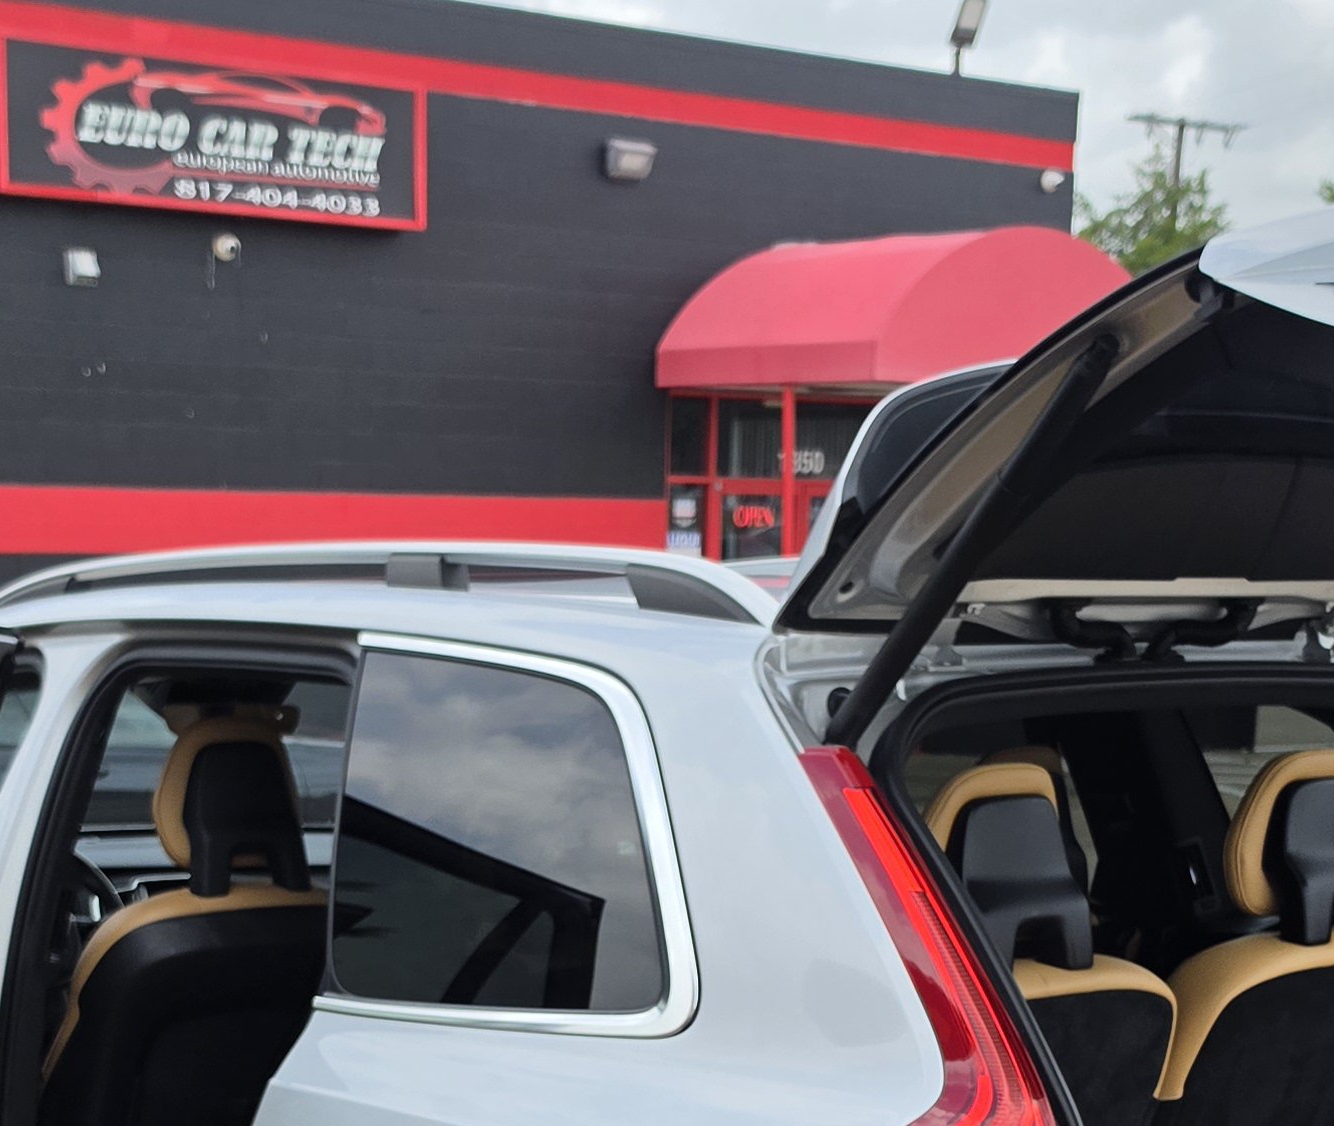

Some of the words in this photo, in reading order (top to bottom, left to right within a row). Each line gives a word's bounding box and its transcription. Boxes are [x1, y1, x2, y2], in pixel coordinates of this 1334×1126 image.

[77, 101, 190, 151] EURO
[198, 114, 279, 161] CAR
[287, 126, 385, 172] TECH
[732, 504, 775, 529] OPEN
